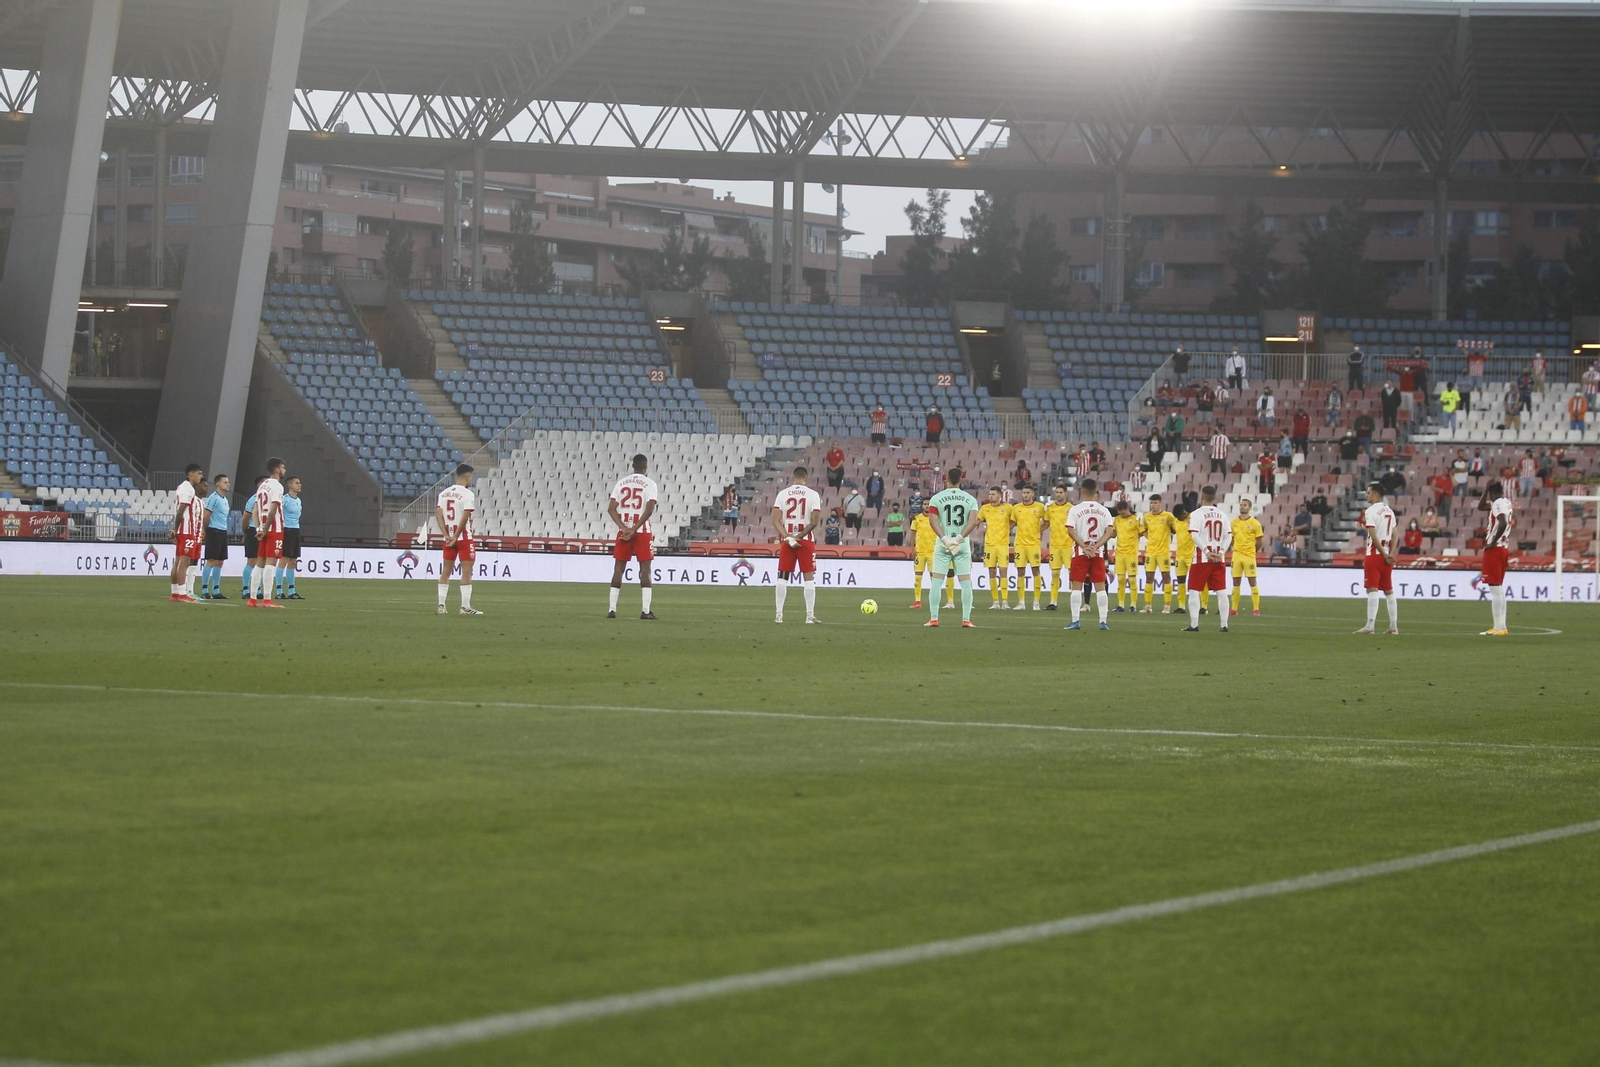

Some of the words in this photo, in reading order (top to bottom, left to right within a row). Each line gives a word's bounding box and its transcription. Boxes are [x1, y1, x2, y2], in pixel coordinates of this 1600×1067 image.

[651, 370, 664, 382] 23
[937, 374, 951, 386] 22
[257, 492, 269, 512] 12
[620, 486, 644, 510] 25
[785, 497, 807, 519] 21
[446, 499, 456, 521] 5
[943, 504, 965, 527] 13
[1087, 516, 1099, 538] 2
[1204, 519, 1223, 542] 10
[1384, 514, 1392, 536] 7
[184, 538, 195, 549] 22
[274, 539, 283, 549] 12
[469, 543, 476, 552] 5
